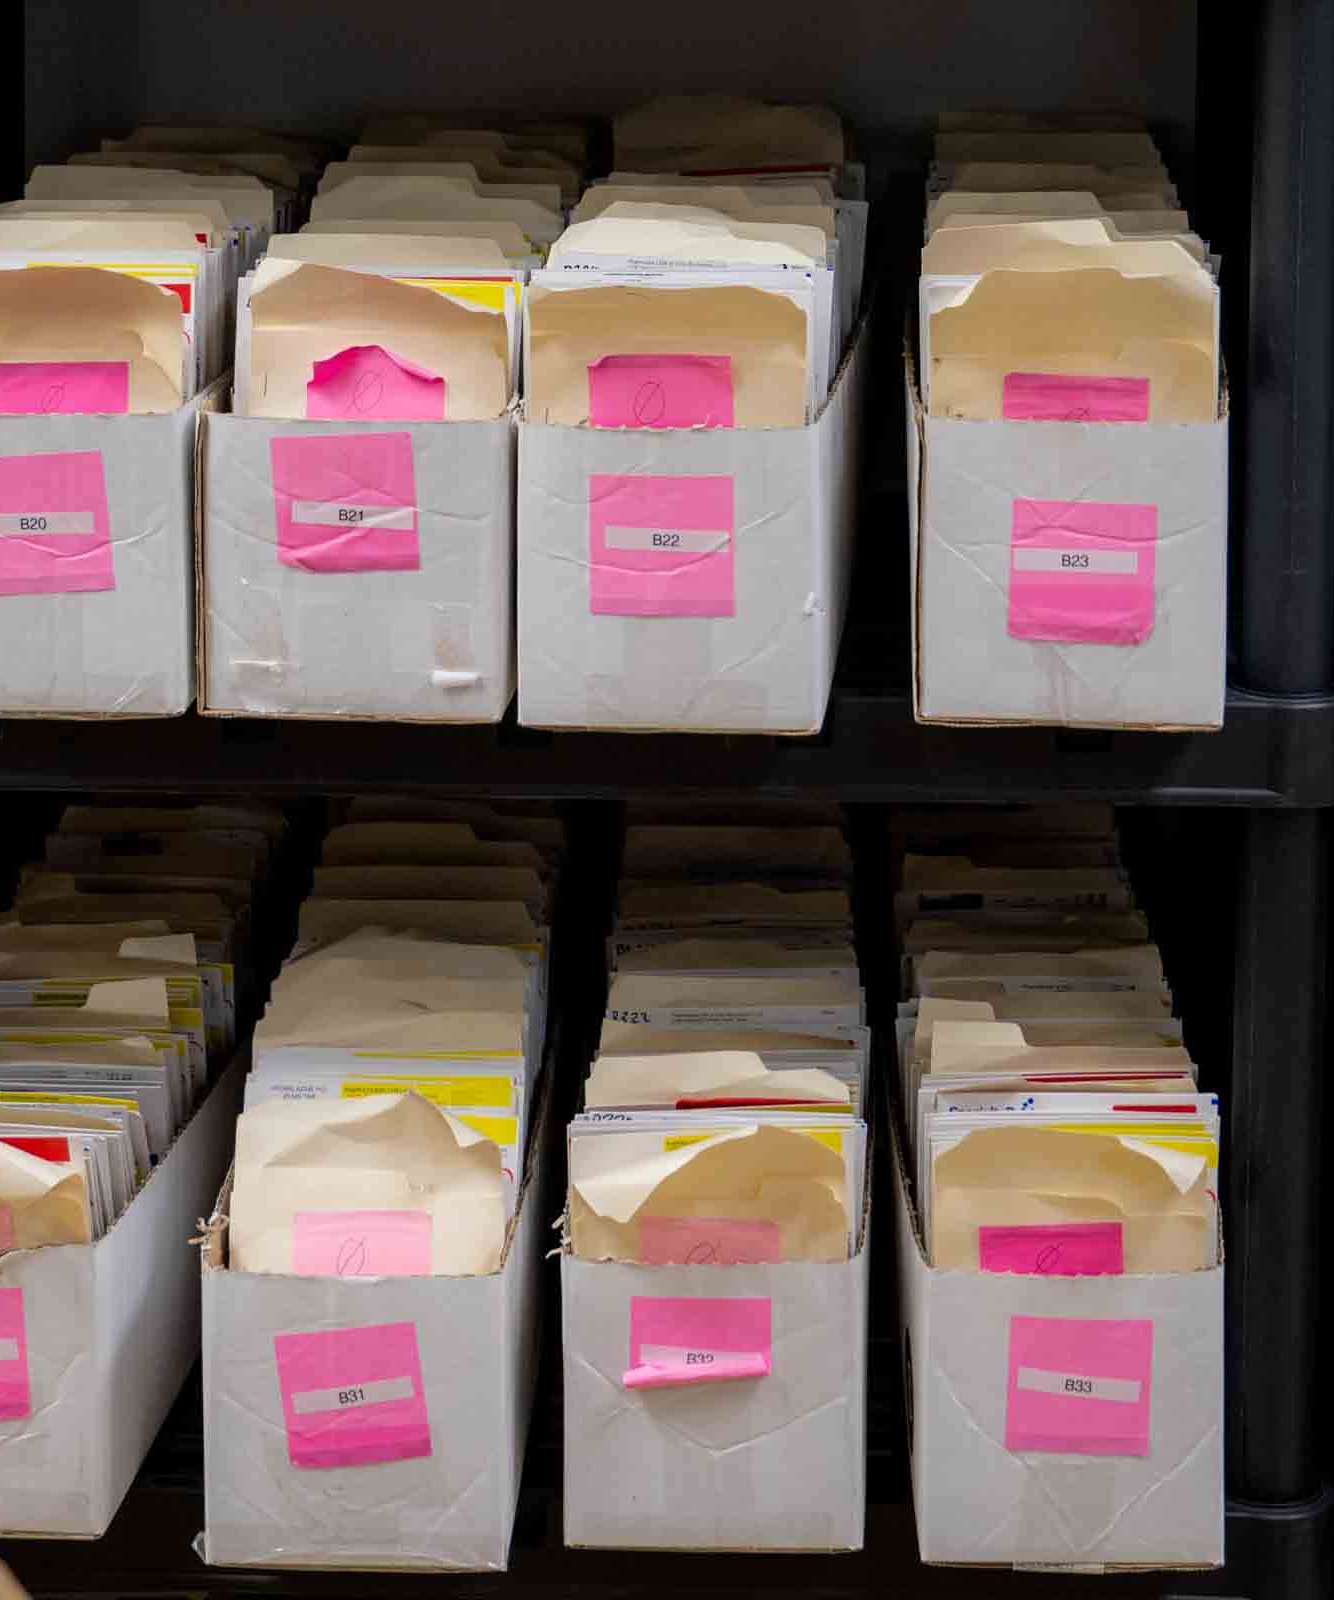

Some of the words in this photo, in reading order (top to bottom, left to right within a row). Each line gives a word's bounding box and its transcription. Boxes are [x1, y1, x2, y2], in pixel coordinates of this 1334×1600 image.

[339, 508, 364, 522] B21
[20, 517, 47, 530] B20
[652, 533, 680, 547] B22
[1061, 554, 1089, 568] B23
[1064, 1379, 1093, 1393] B33
[339, 1388, 365, 1404] B31
